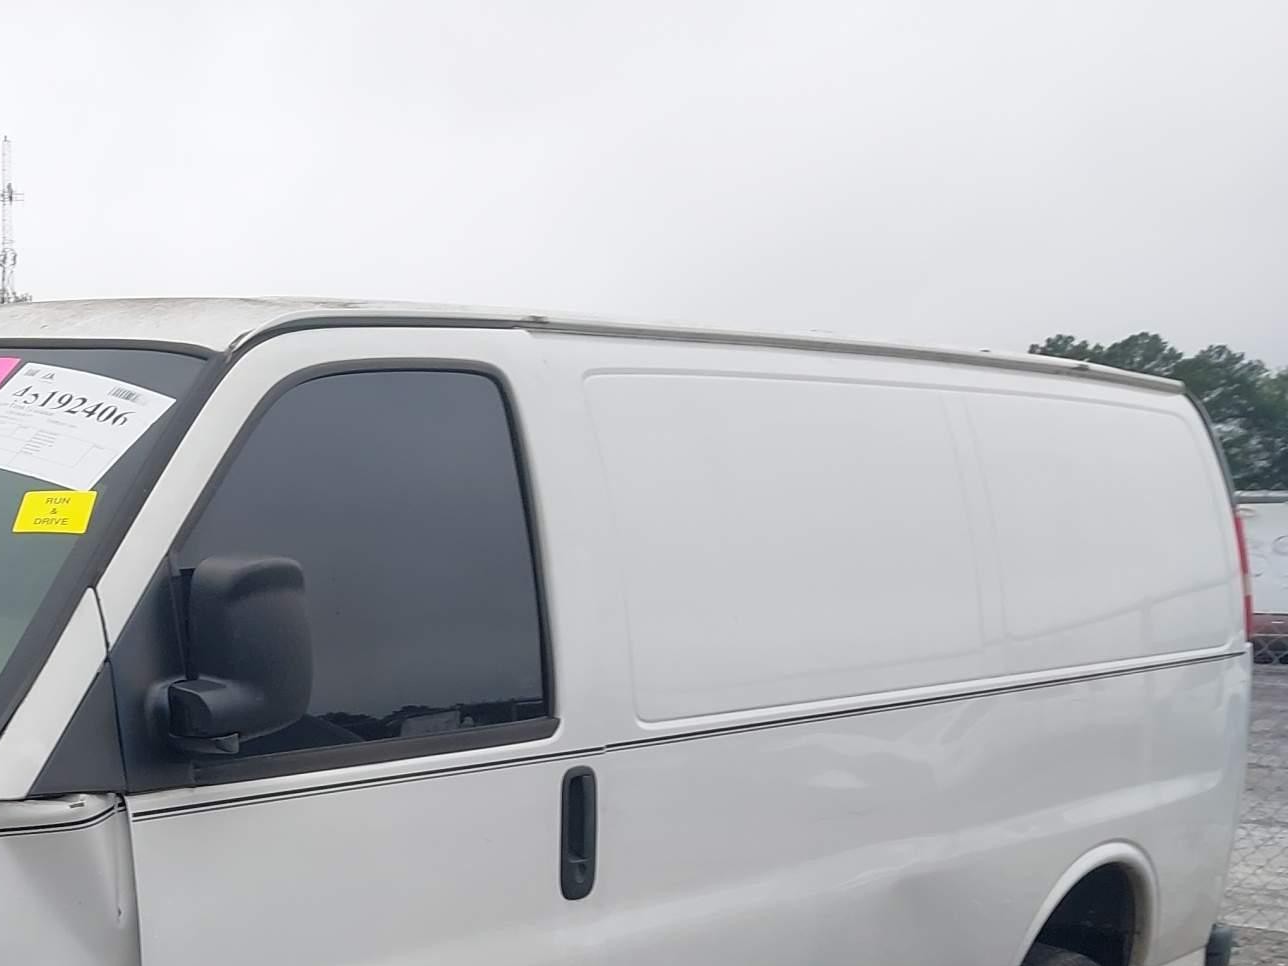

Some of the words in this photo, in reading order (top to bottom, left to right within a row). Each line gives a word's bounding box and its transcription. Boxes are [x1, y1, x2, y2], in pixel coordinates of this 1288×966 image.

[45, 497, 72, 505] RUN
[50, 507, 58, 515] &
[33, 517, 69, 526] DRIVE
